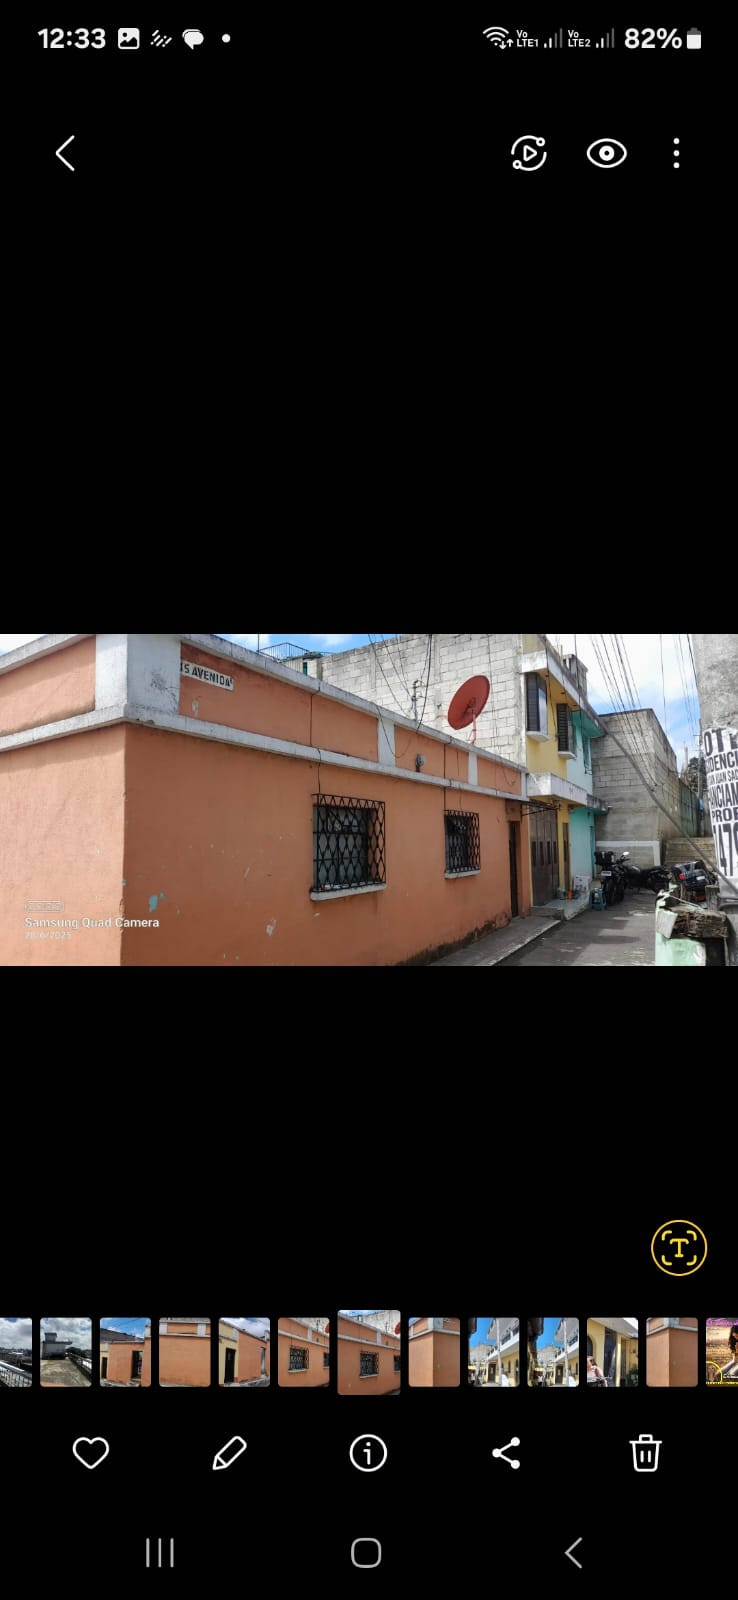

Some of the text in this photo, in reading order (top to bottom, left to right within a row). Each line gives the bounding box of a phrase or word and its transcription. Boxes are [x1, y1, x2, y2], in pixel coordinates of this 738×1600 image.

[37, 28, 106, 49] 12:33
[516, 29, 528, 38] Vo
[568, 29, 580, 38] Vo
[624, 27, 683, 49] 82%
[516, 38, 539, 48] LTE1
[568, 38, 591, 48] LTE2
[191, 666, 233, 687] AVENIDA
